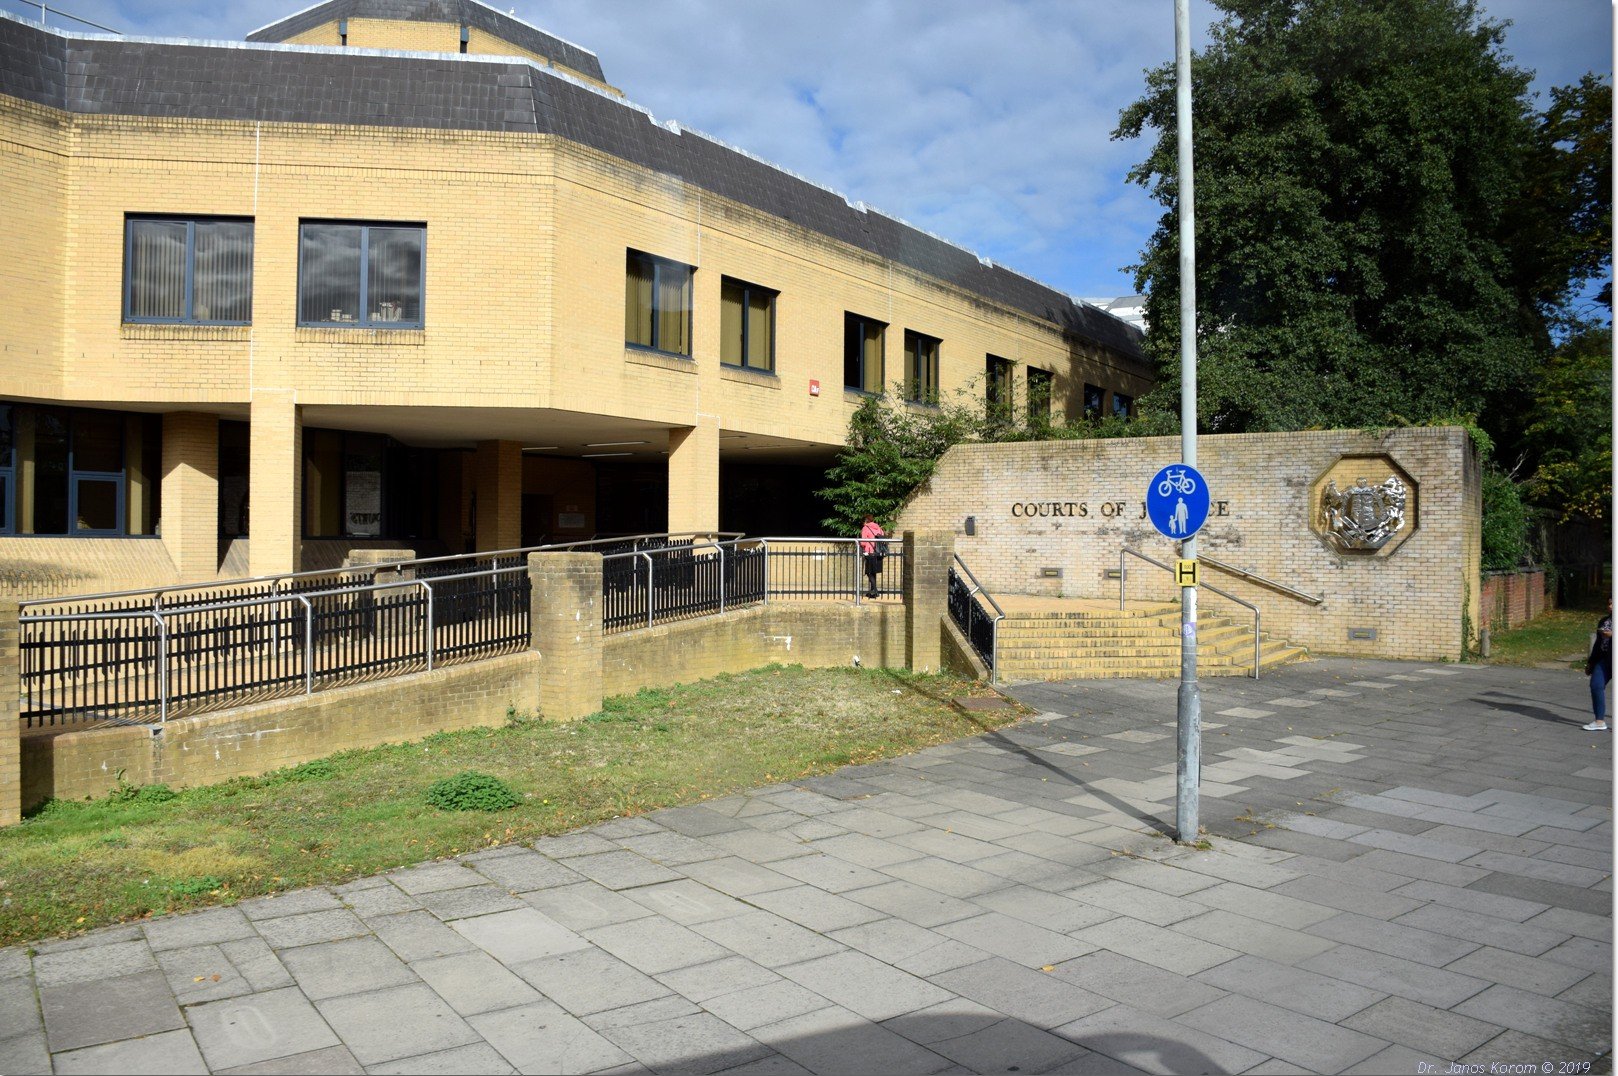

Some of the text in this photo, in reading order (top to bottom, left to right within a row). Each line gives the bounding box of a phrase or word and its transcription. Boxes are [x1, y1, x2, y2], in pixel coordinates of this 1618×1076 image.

[1012, 502, 1088, 517] COURTS
[1100, 501, 1126, 517] OF
[1180, 562, 1196, 583] H
